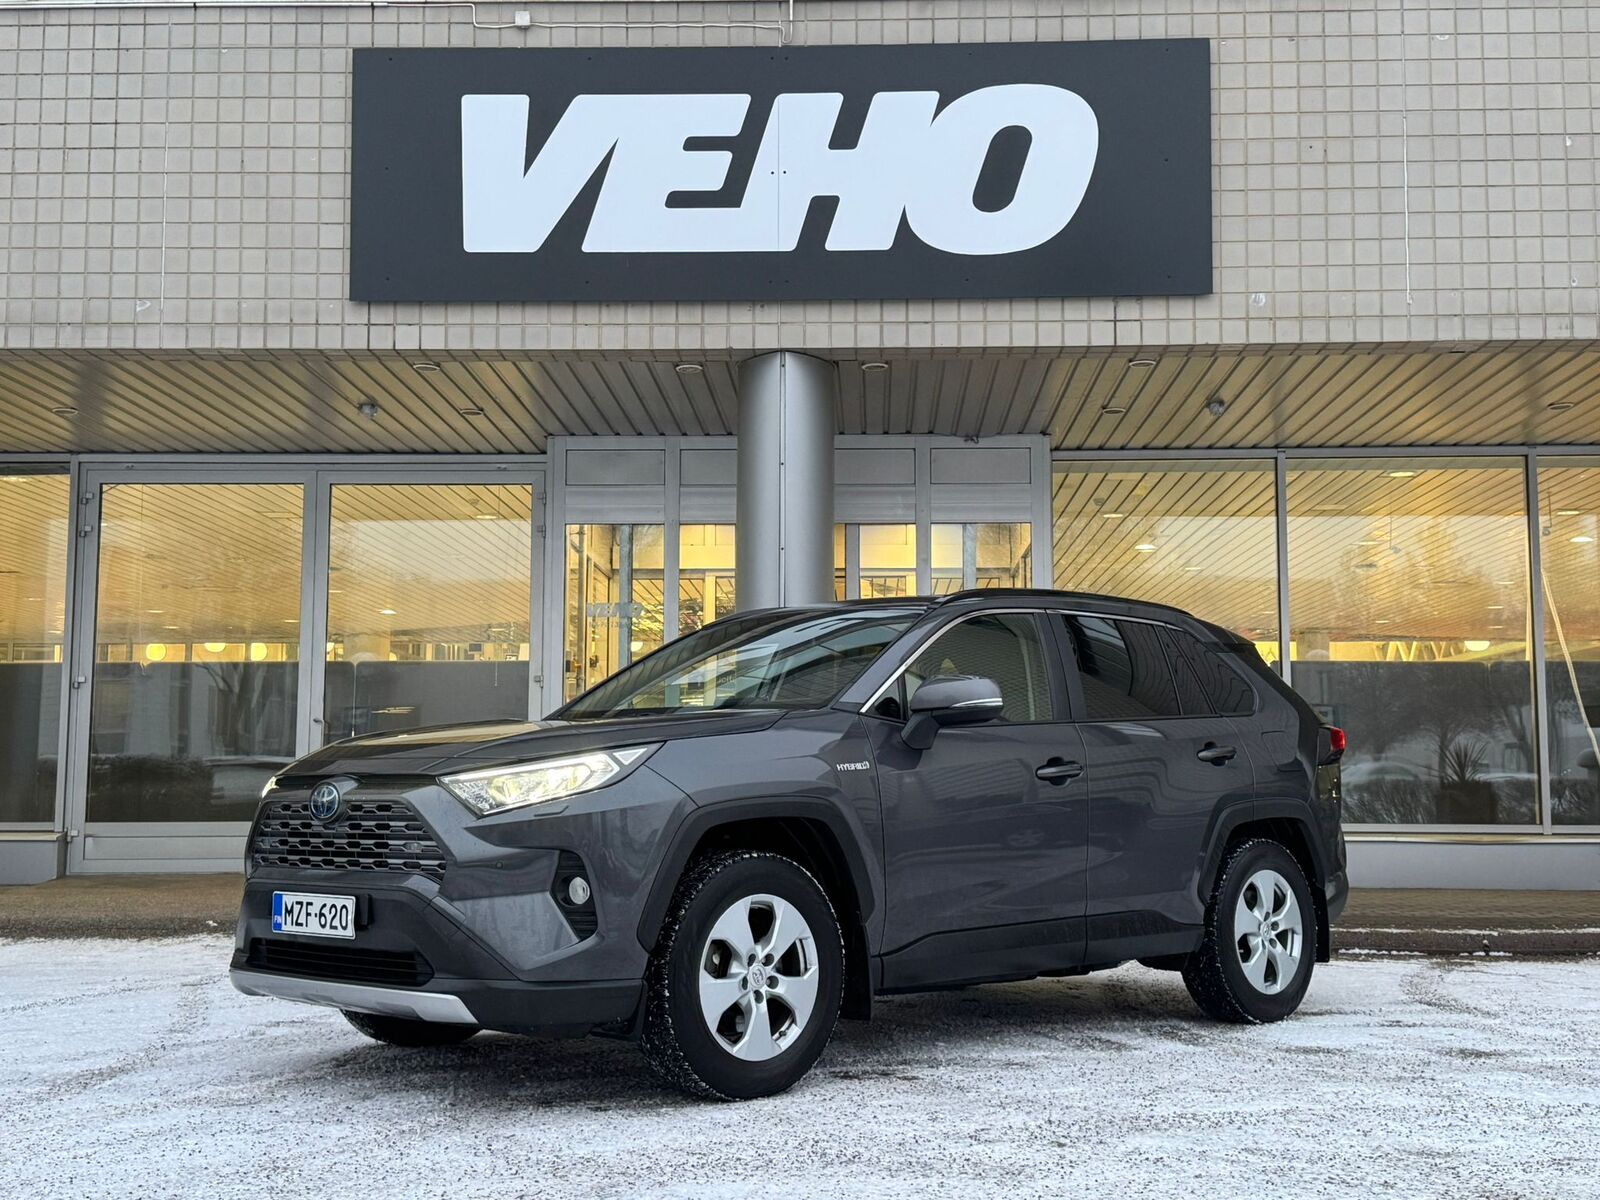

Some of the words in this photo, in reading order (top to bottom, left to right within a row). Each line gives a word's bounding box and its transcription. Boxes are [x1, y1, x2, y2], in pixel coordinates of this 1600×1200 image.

[461, 84, 1099, 255] VEHO
[836, 761, 869, 771] HYBRID
[284, 900, 349, 931] MZF-620
